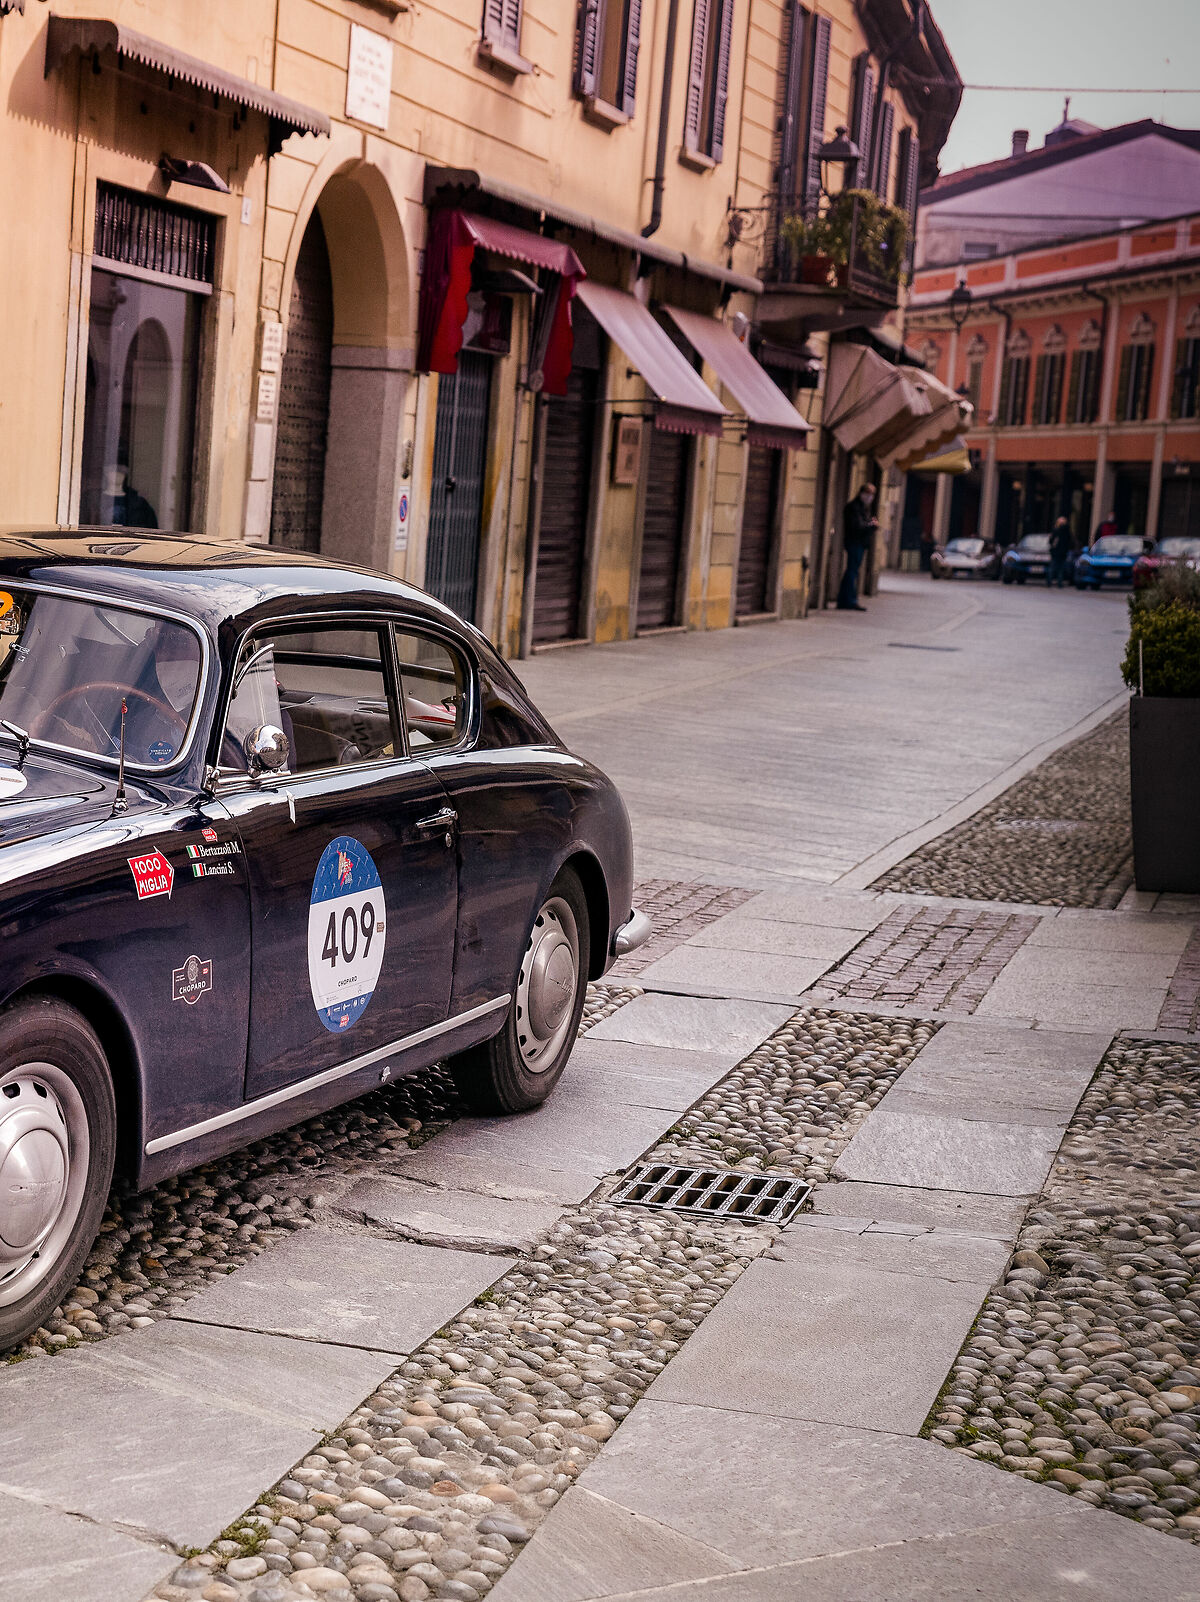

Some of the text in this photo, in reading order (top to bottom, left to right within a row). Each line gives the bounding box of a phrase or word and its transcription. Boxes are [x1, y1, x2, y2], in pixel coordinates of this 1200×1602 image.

[198, 841, 242, 857] Bertazzoli M.
[134, 857, 162, 875] 1000
[203, 861, 235, 876] Lancini S.
[139, 874, 169, 895] MIGLIA
[321, 901, 376, 968] 409
[179, 981, 206, 994] CHOPARD
[337, 975, 358, 987] CHOPARD
